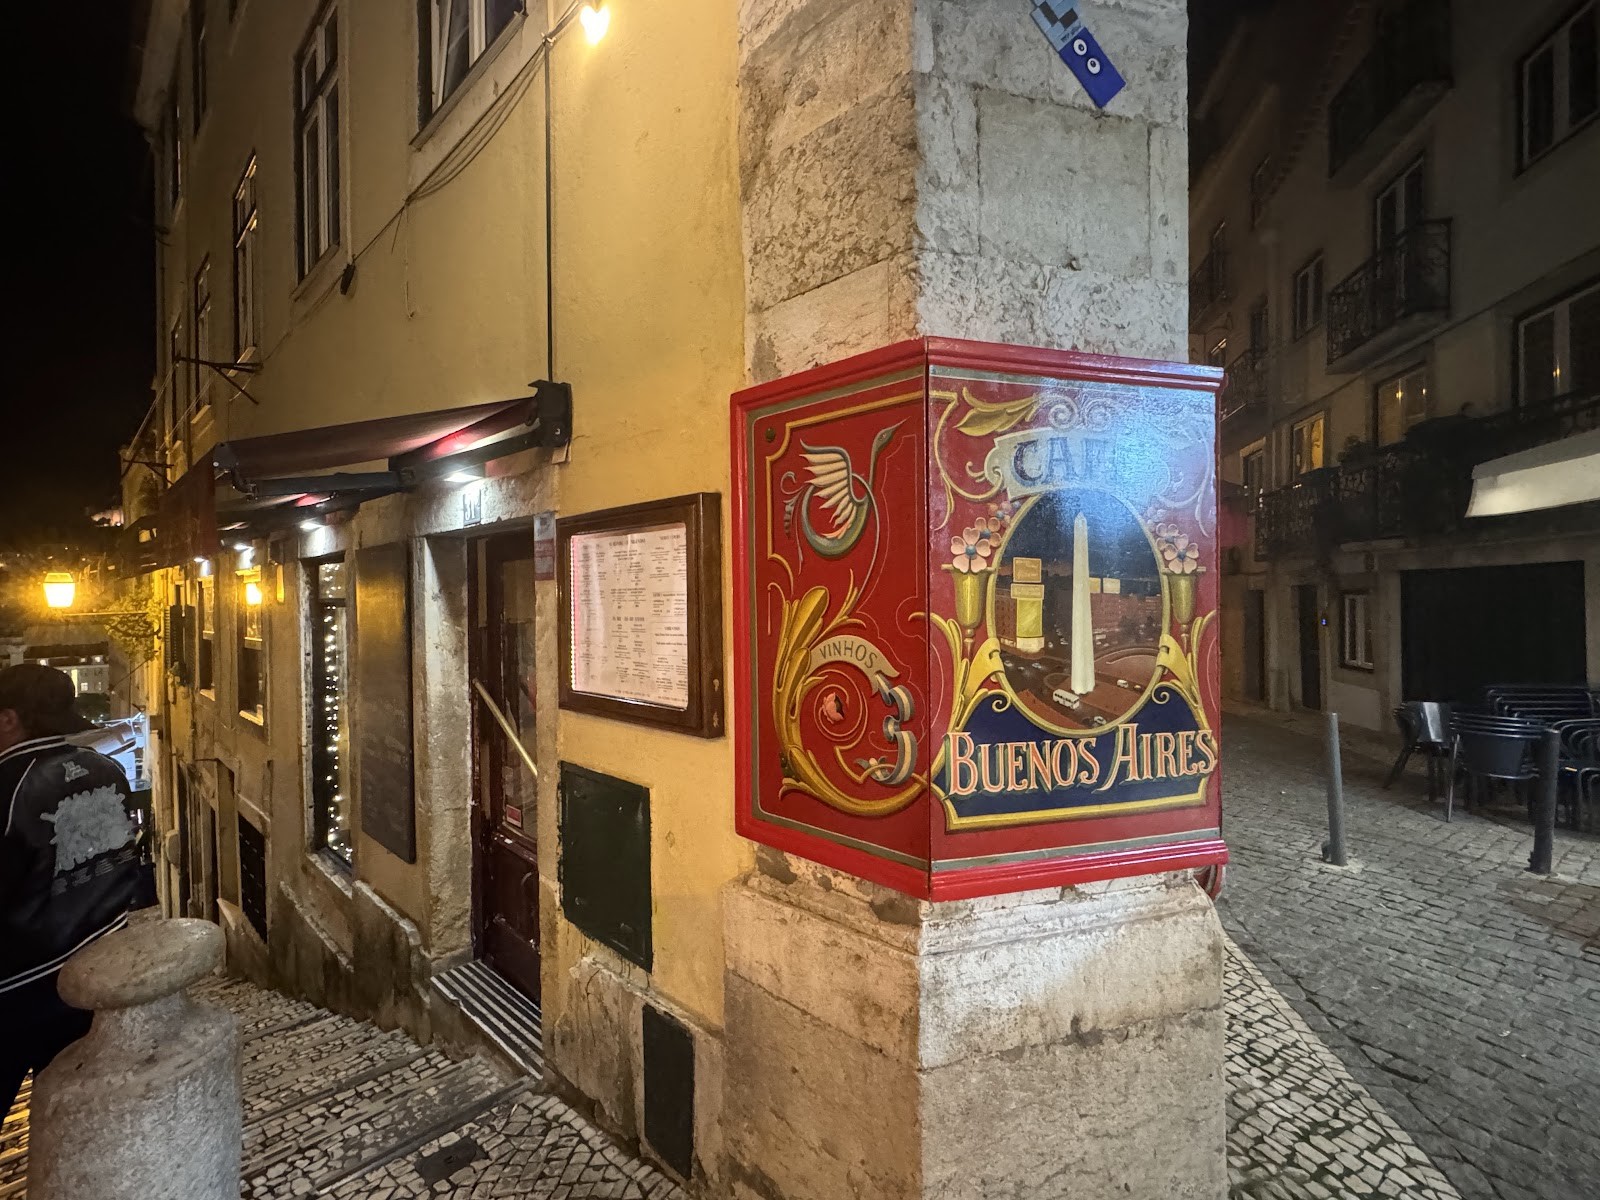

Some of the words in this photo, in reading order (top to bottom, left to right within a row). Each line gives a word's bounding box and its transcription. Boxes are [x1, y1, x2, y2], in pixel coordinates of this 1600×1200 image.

[819, 640, 878, 669] VINHOS
[945, 731, 1100, 796] BUENOS
[1096, 723, 1219, 791] AIRES
